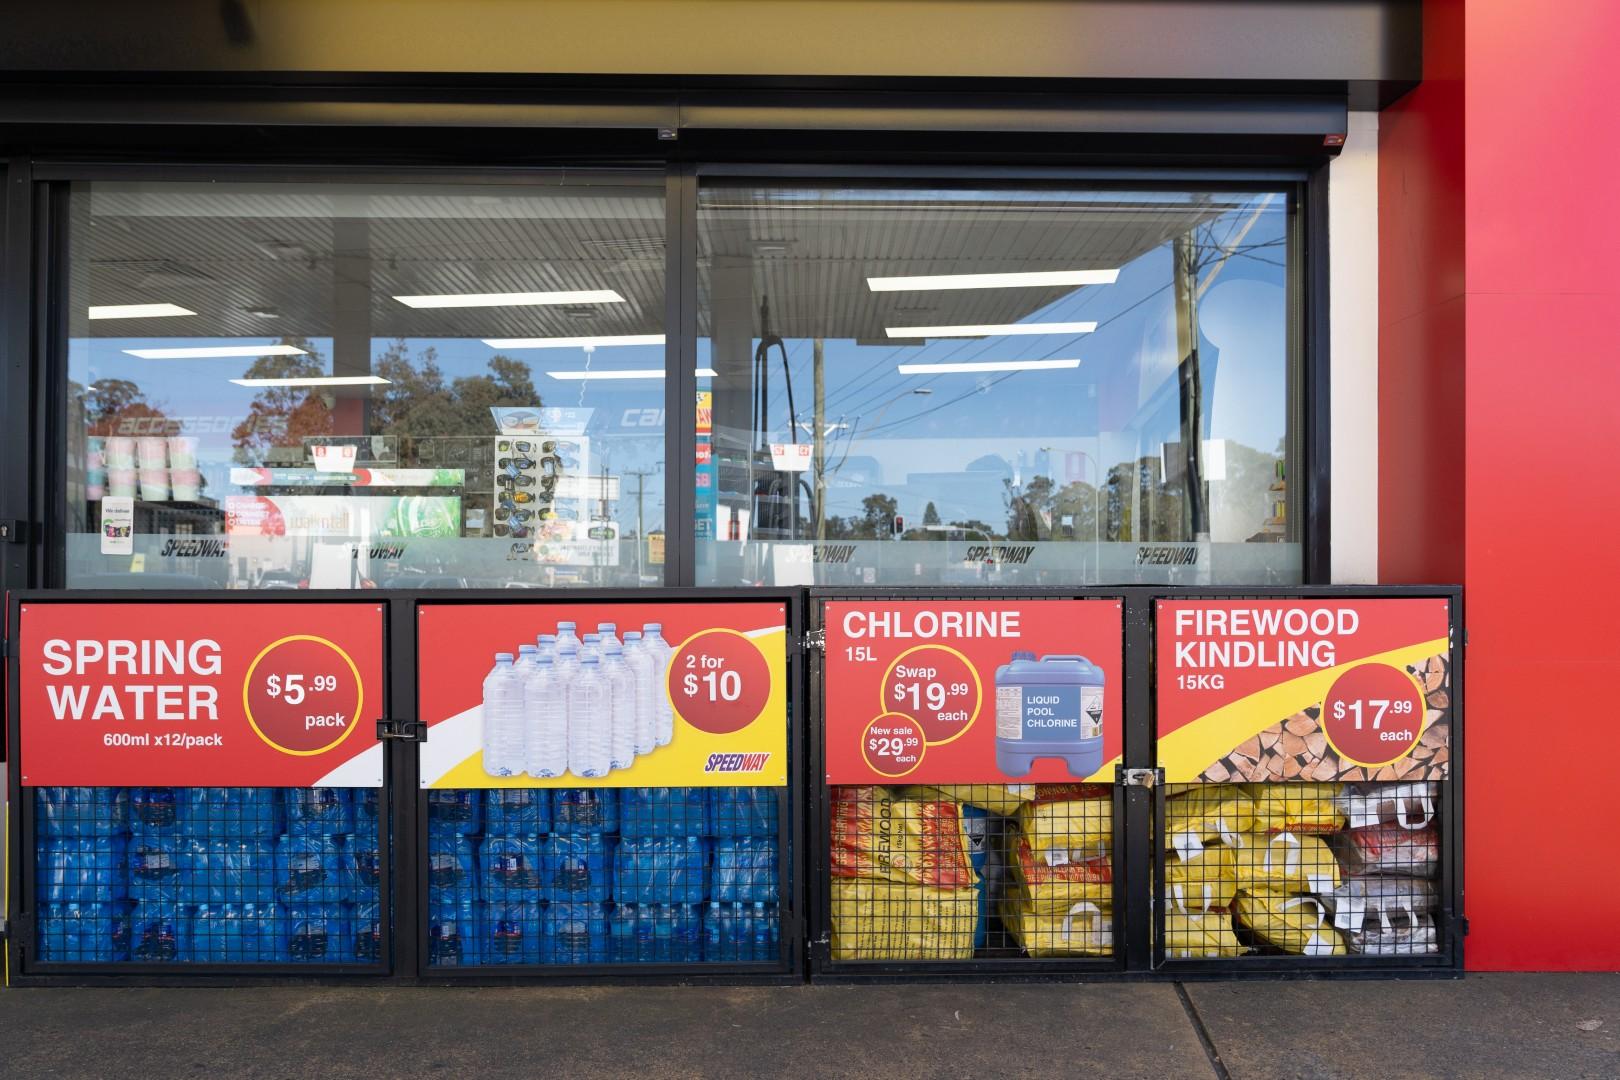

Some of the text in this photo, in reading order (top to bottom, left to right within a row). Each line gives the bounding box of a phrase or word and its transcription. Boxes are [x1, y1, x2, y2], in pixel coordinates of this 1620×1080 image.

[843, 610, 1021, 638] CHLORINE
[1175, 608, 1360, 636] FIREWOOD
[42, 638, 222, 676] SPRING
[686, 654, 725, 669] 2 for
[845, 646, 877, 662] 15L
[1175, 640, 1336, 668] KINDLING
[895, 665, 937, 681] Swap
[683, 670, 742, 702] $10
[1177, 674, 1225, 690] 15KG
[46, 685, 219, 720] WATER
[893, 682, 969, 711] $19.99
[1026, 695, 1060, 705] LIQUID
[937, 710, 968, 721] each
[1026, 707, 1055, 716] POOL
[1333, 699, 1412, 730] $17.99
[305, 712, 346, 731] pack
[1026, 718, 1078, 728] CHLORINE
[870, 726, 913, 735] New sale
[1380, 729, 1413, 741] each
[103, 733, 223, 749] 600ml x12/pack
[869, 737, 919, 756] $29.99
[704, 752, 771, 773] SPEEDWAY
[895, 754, 917, 763] each
[878, 797, 892, 875] FIREWOOD
